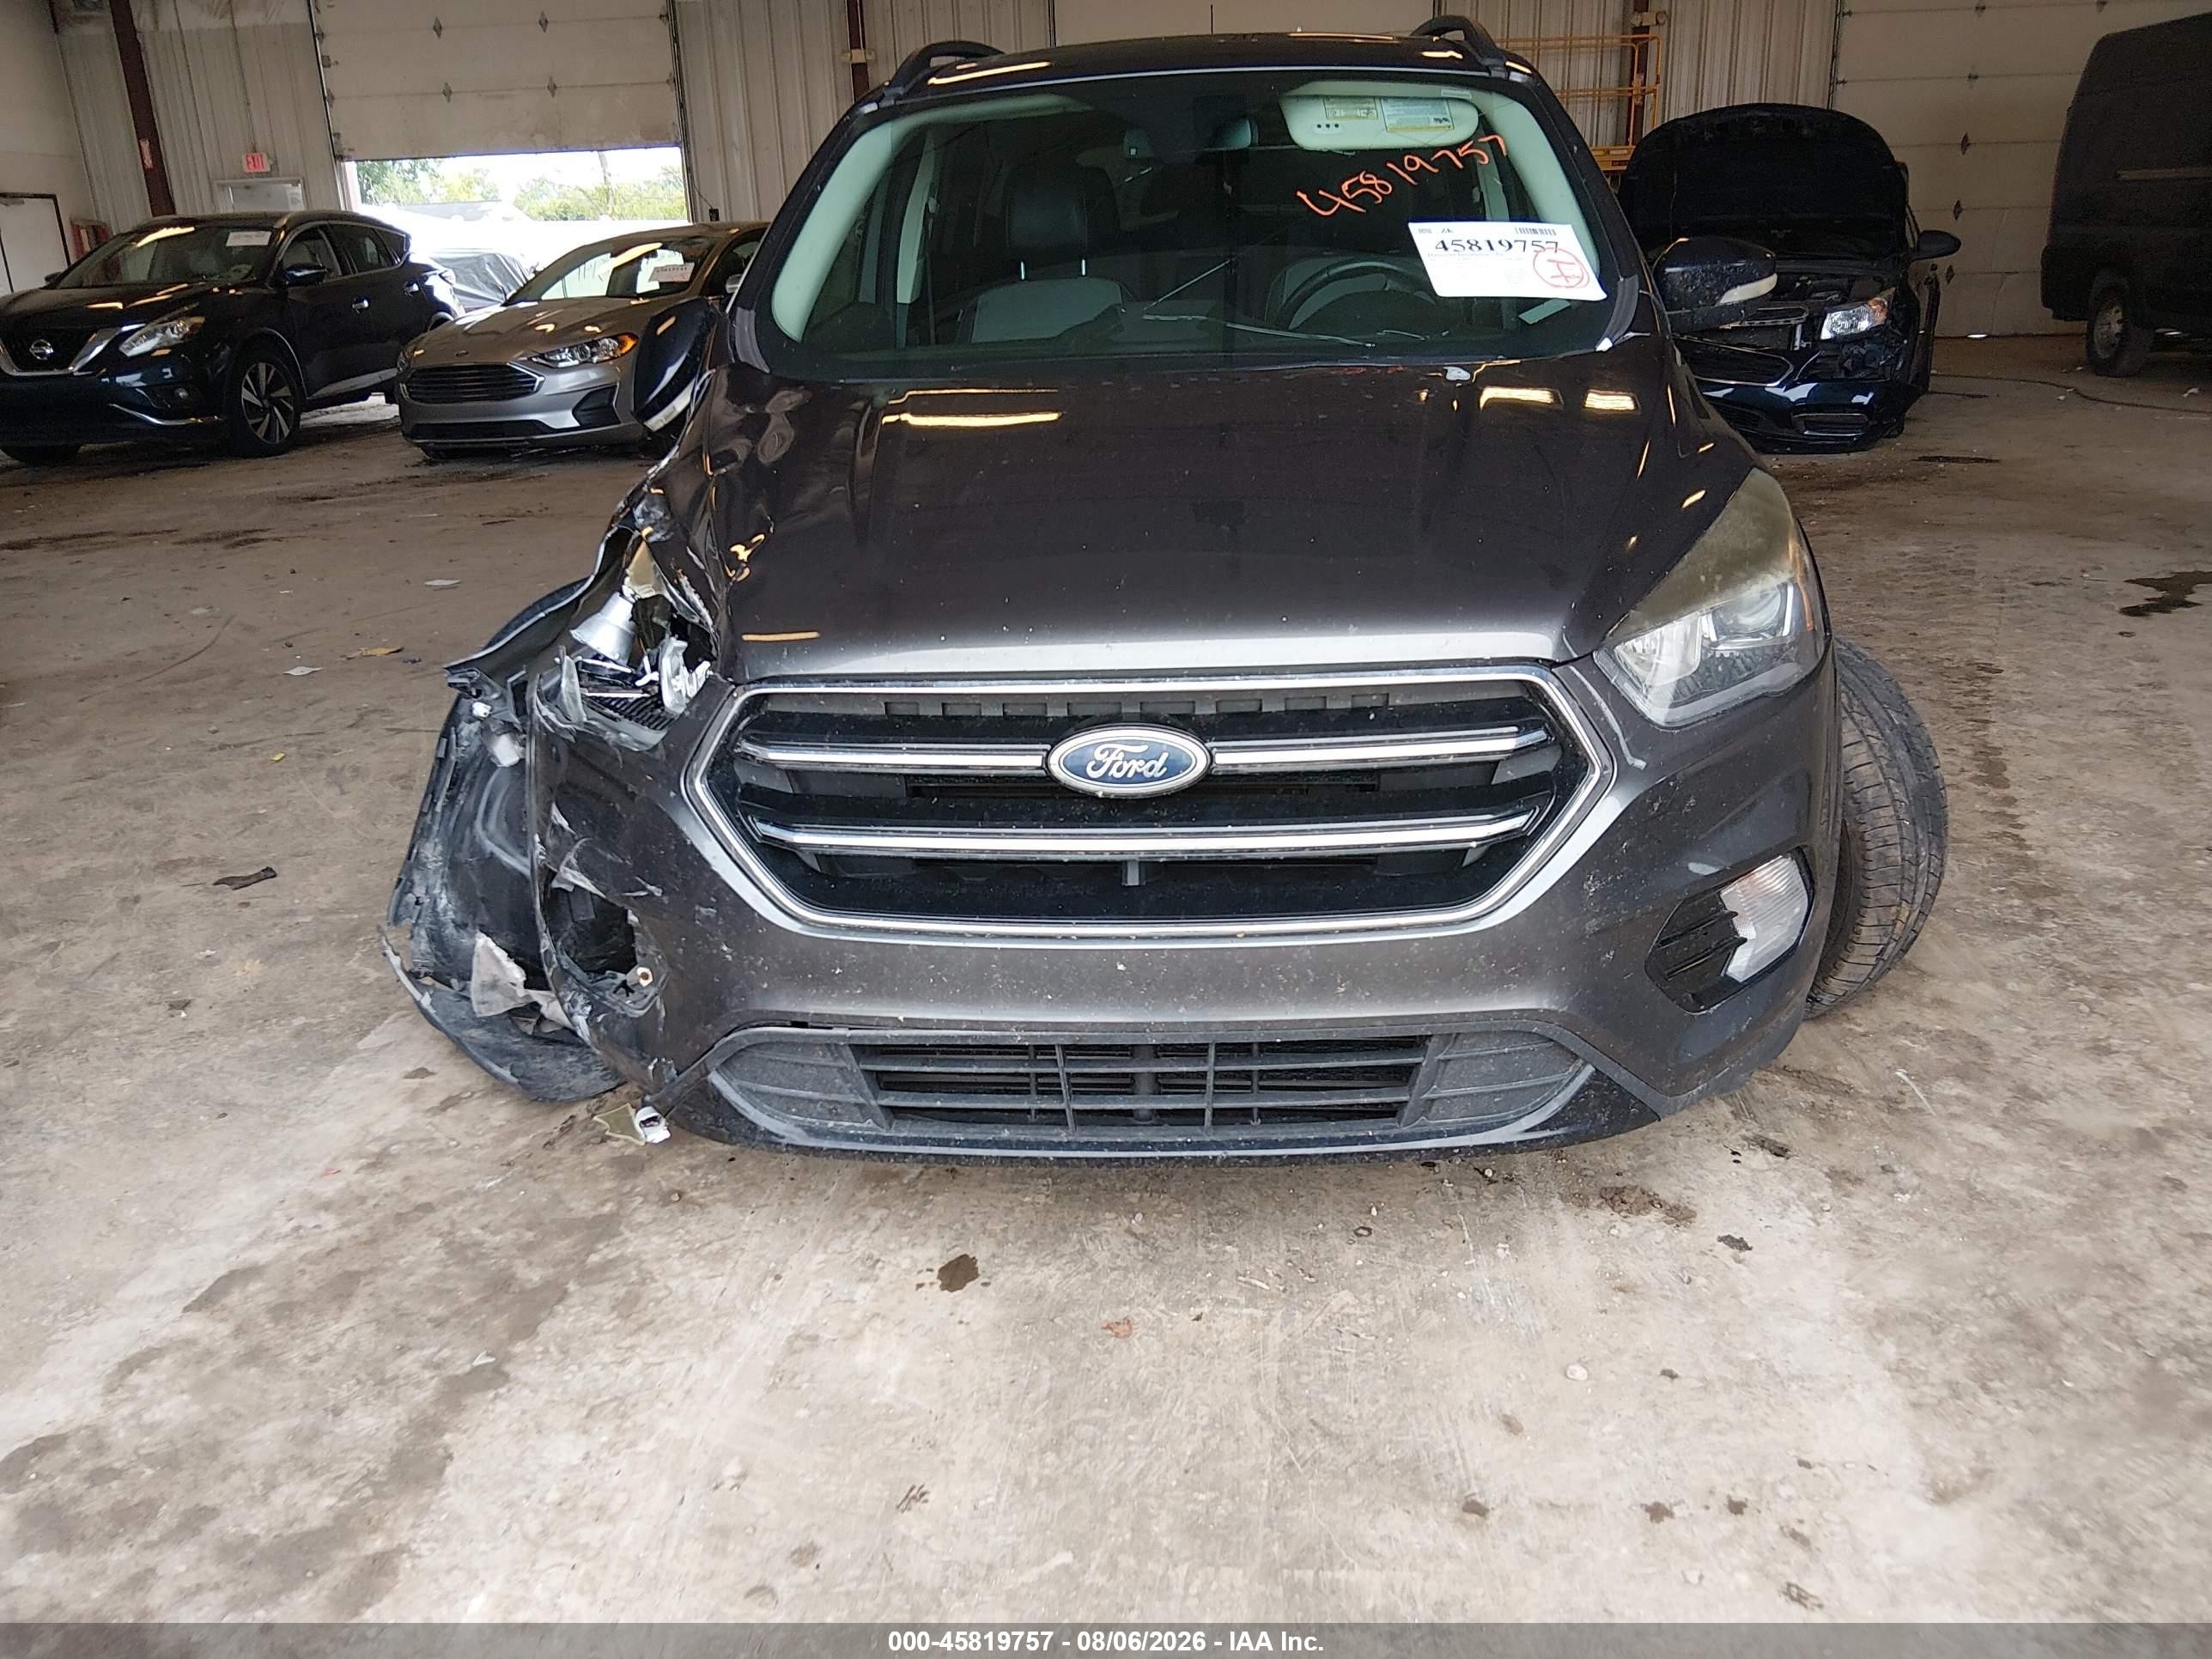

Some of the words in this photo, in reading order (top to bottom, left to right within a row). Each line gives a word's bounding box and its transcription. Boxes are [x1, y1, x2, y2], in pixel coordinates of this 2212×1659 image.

[246, 154, 264, 171] EXIT
[1297, 134, 1508, 217] 45819757
[1435, 239, 1559, 253] 45819757
[1085, 743, 1170, 779] Ford
